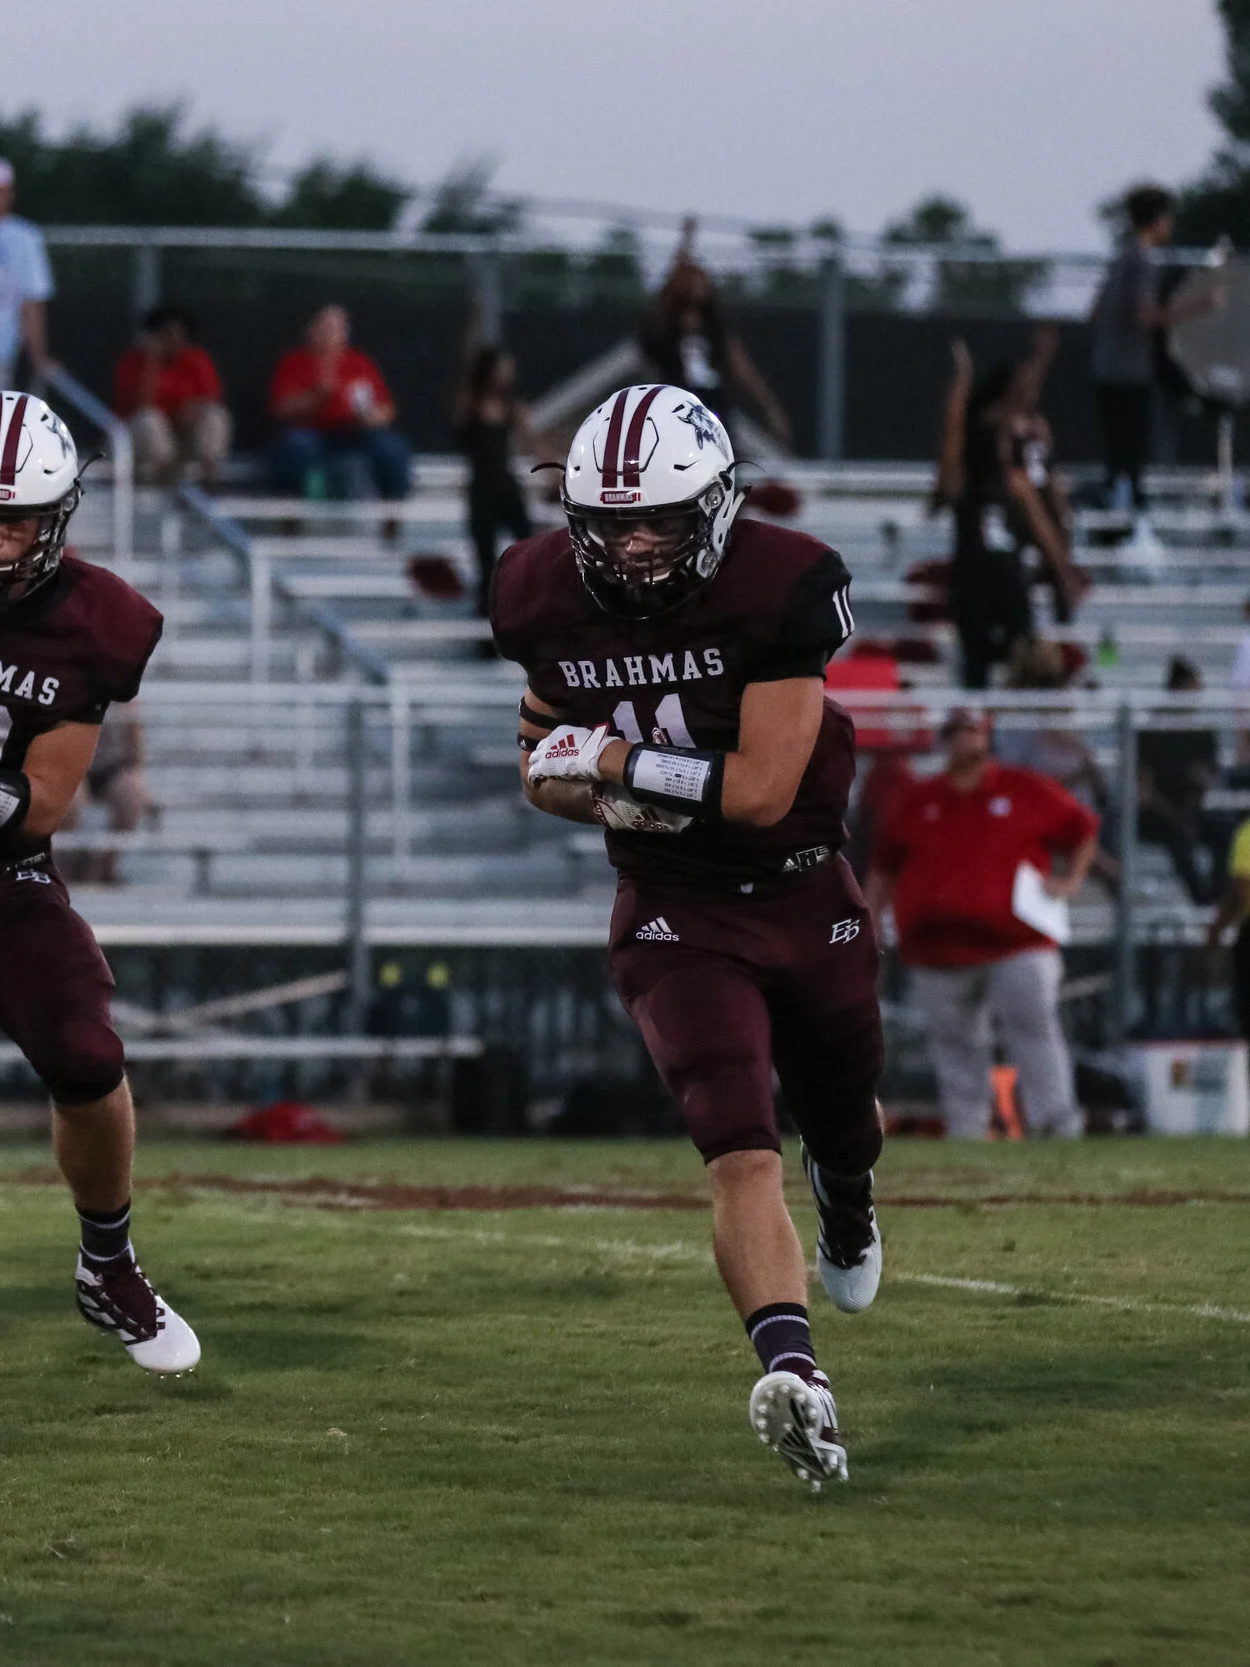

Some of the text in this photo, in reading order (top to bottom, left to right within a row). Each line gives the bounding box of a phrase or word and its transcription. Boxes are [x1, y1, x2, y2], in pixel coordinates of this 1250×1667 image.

[832, 585, 855, 639] 11
[558, 648, 724, 689] BRAHMAS
[612, 692, 698, 749] 11
[545, 747, 579, 760] adidas
[636, 930, 680, 942] adidas
